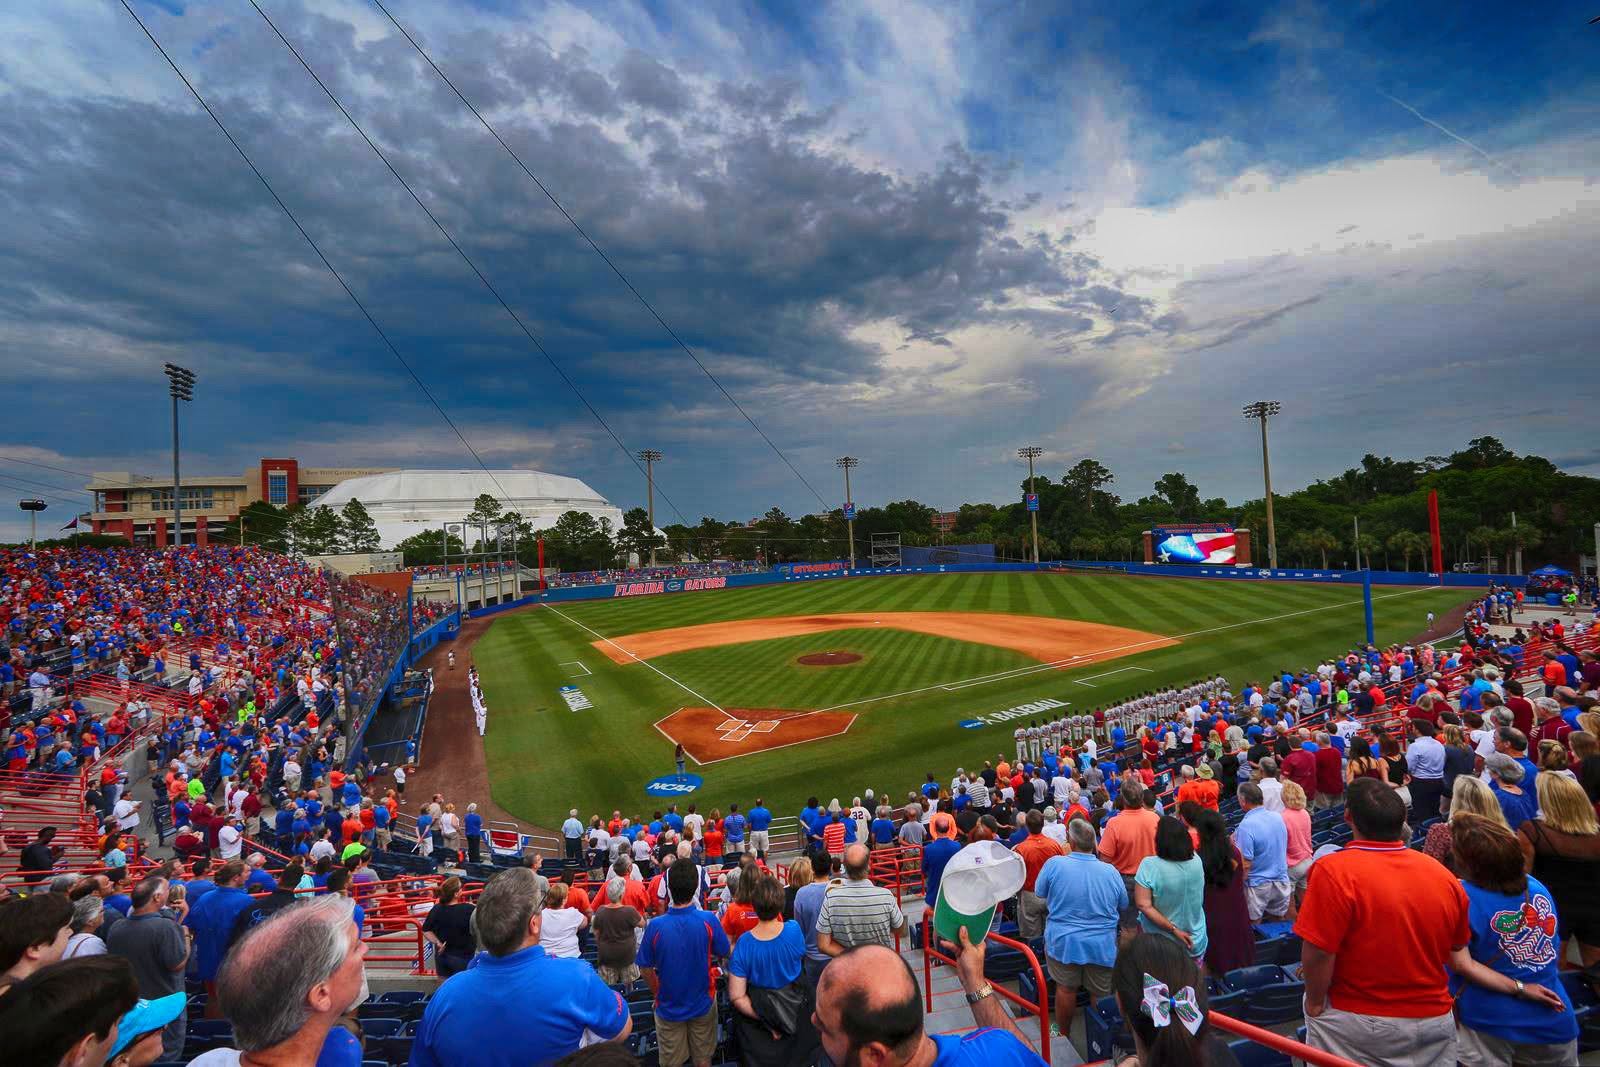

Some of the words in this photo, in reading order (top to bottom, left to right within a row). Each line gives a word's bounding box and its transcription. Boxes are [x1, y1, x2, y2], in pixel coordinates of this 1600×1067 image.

[614, 582, 665, 597] FLORIDA
[684, 577, 726, 591] GATORS
[988, 698, 1072, 723] BASEBALL
[647, 782, 697, 793] NCAA
[852, 811, 864, 820] 32
